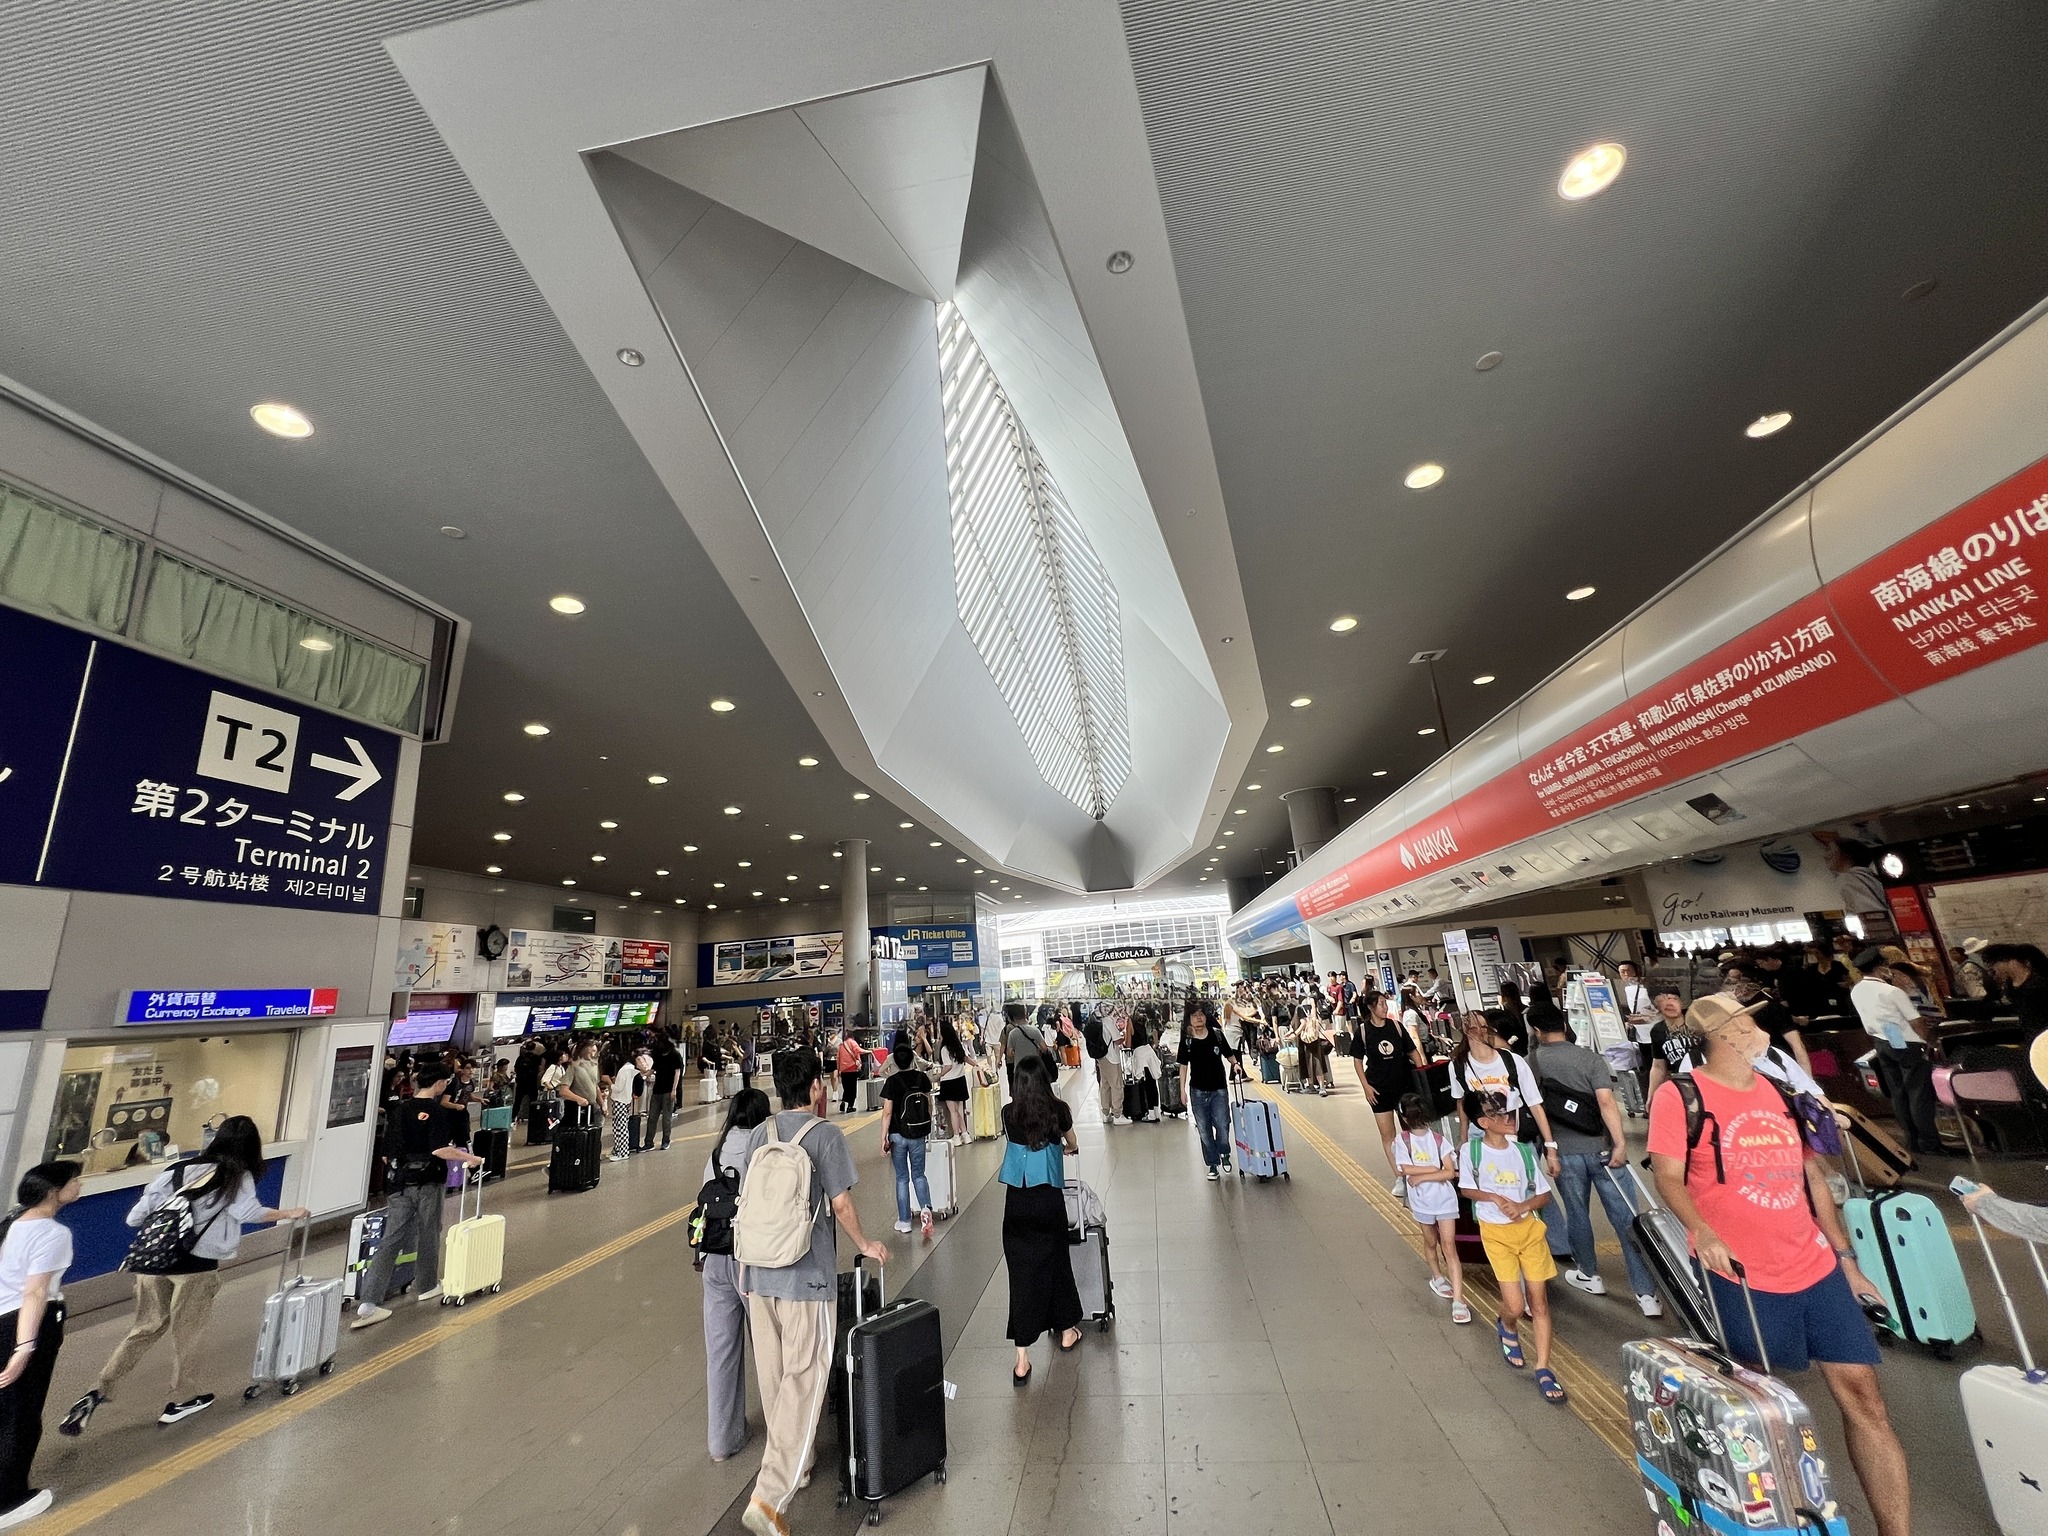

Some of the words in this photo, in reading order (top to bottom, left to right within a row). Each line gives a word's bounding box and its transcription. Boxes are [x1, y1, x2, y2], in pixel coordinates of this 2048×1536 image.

[1869, 493, 2048, 612] 南海線のりば
[1892, 583, 1975, 632] NANKAI
[1973, 556, 2033, 594] LINE
[1908, 611, 1978, 649] 난카이선
[1976, 584, 2038, 618] 타는곳
[1923, 637, 1980, 666] 南海线
[1975, 612, 2037, 645] 乘车处
[1752, 685, 1765, 697] at
[1761, 650, 1838, 693] IZUMISANO)
[1725, 712, 1750, 731] 방면
[216, 714, 289, 774] T2
[131, 778, 374, 850] 第2ターミナル
[1413, 826, 1459, 866] NANKAI
[234, 838, 347, 877] Terminal
[357, 858, 371, 880] 2
[284, 880, 367, 903] 제2터미널
[1680, 912, 1710, 922] Kyoto
[1710, 909, 1750, 919] Railway
[1751, 906, 1795, 916] Museum
[902, 929, 920, 941] JR
[921, 930, 945, 940] Ticket
[945, 929, 966, 939] Office
[1105, 949, 1151, 961] AEROPLAZA
[148, 992, 217, 1007] 外貨両替
[265, 1004, 307, 1016] Travelex
[826, 1003, 843, 1014] JR
[144, 1006, 199, 1019] Currency
[201, 1006, 251, 1017] Exchange
[1738, 1132, 1783, 1148] OHANA
